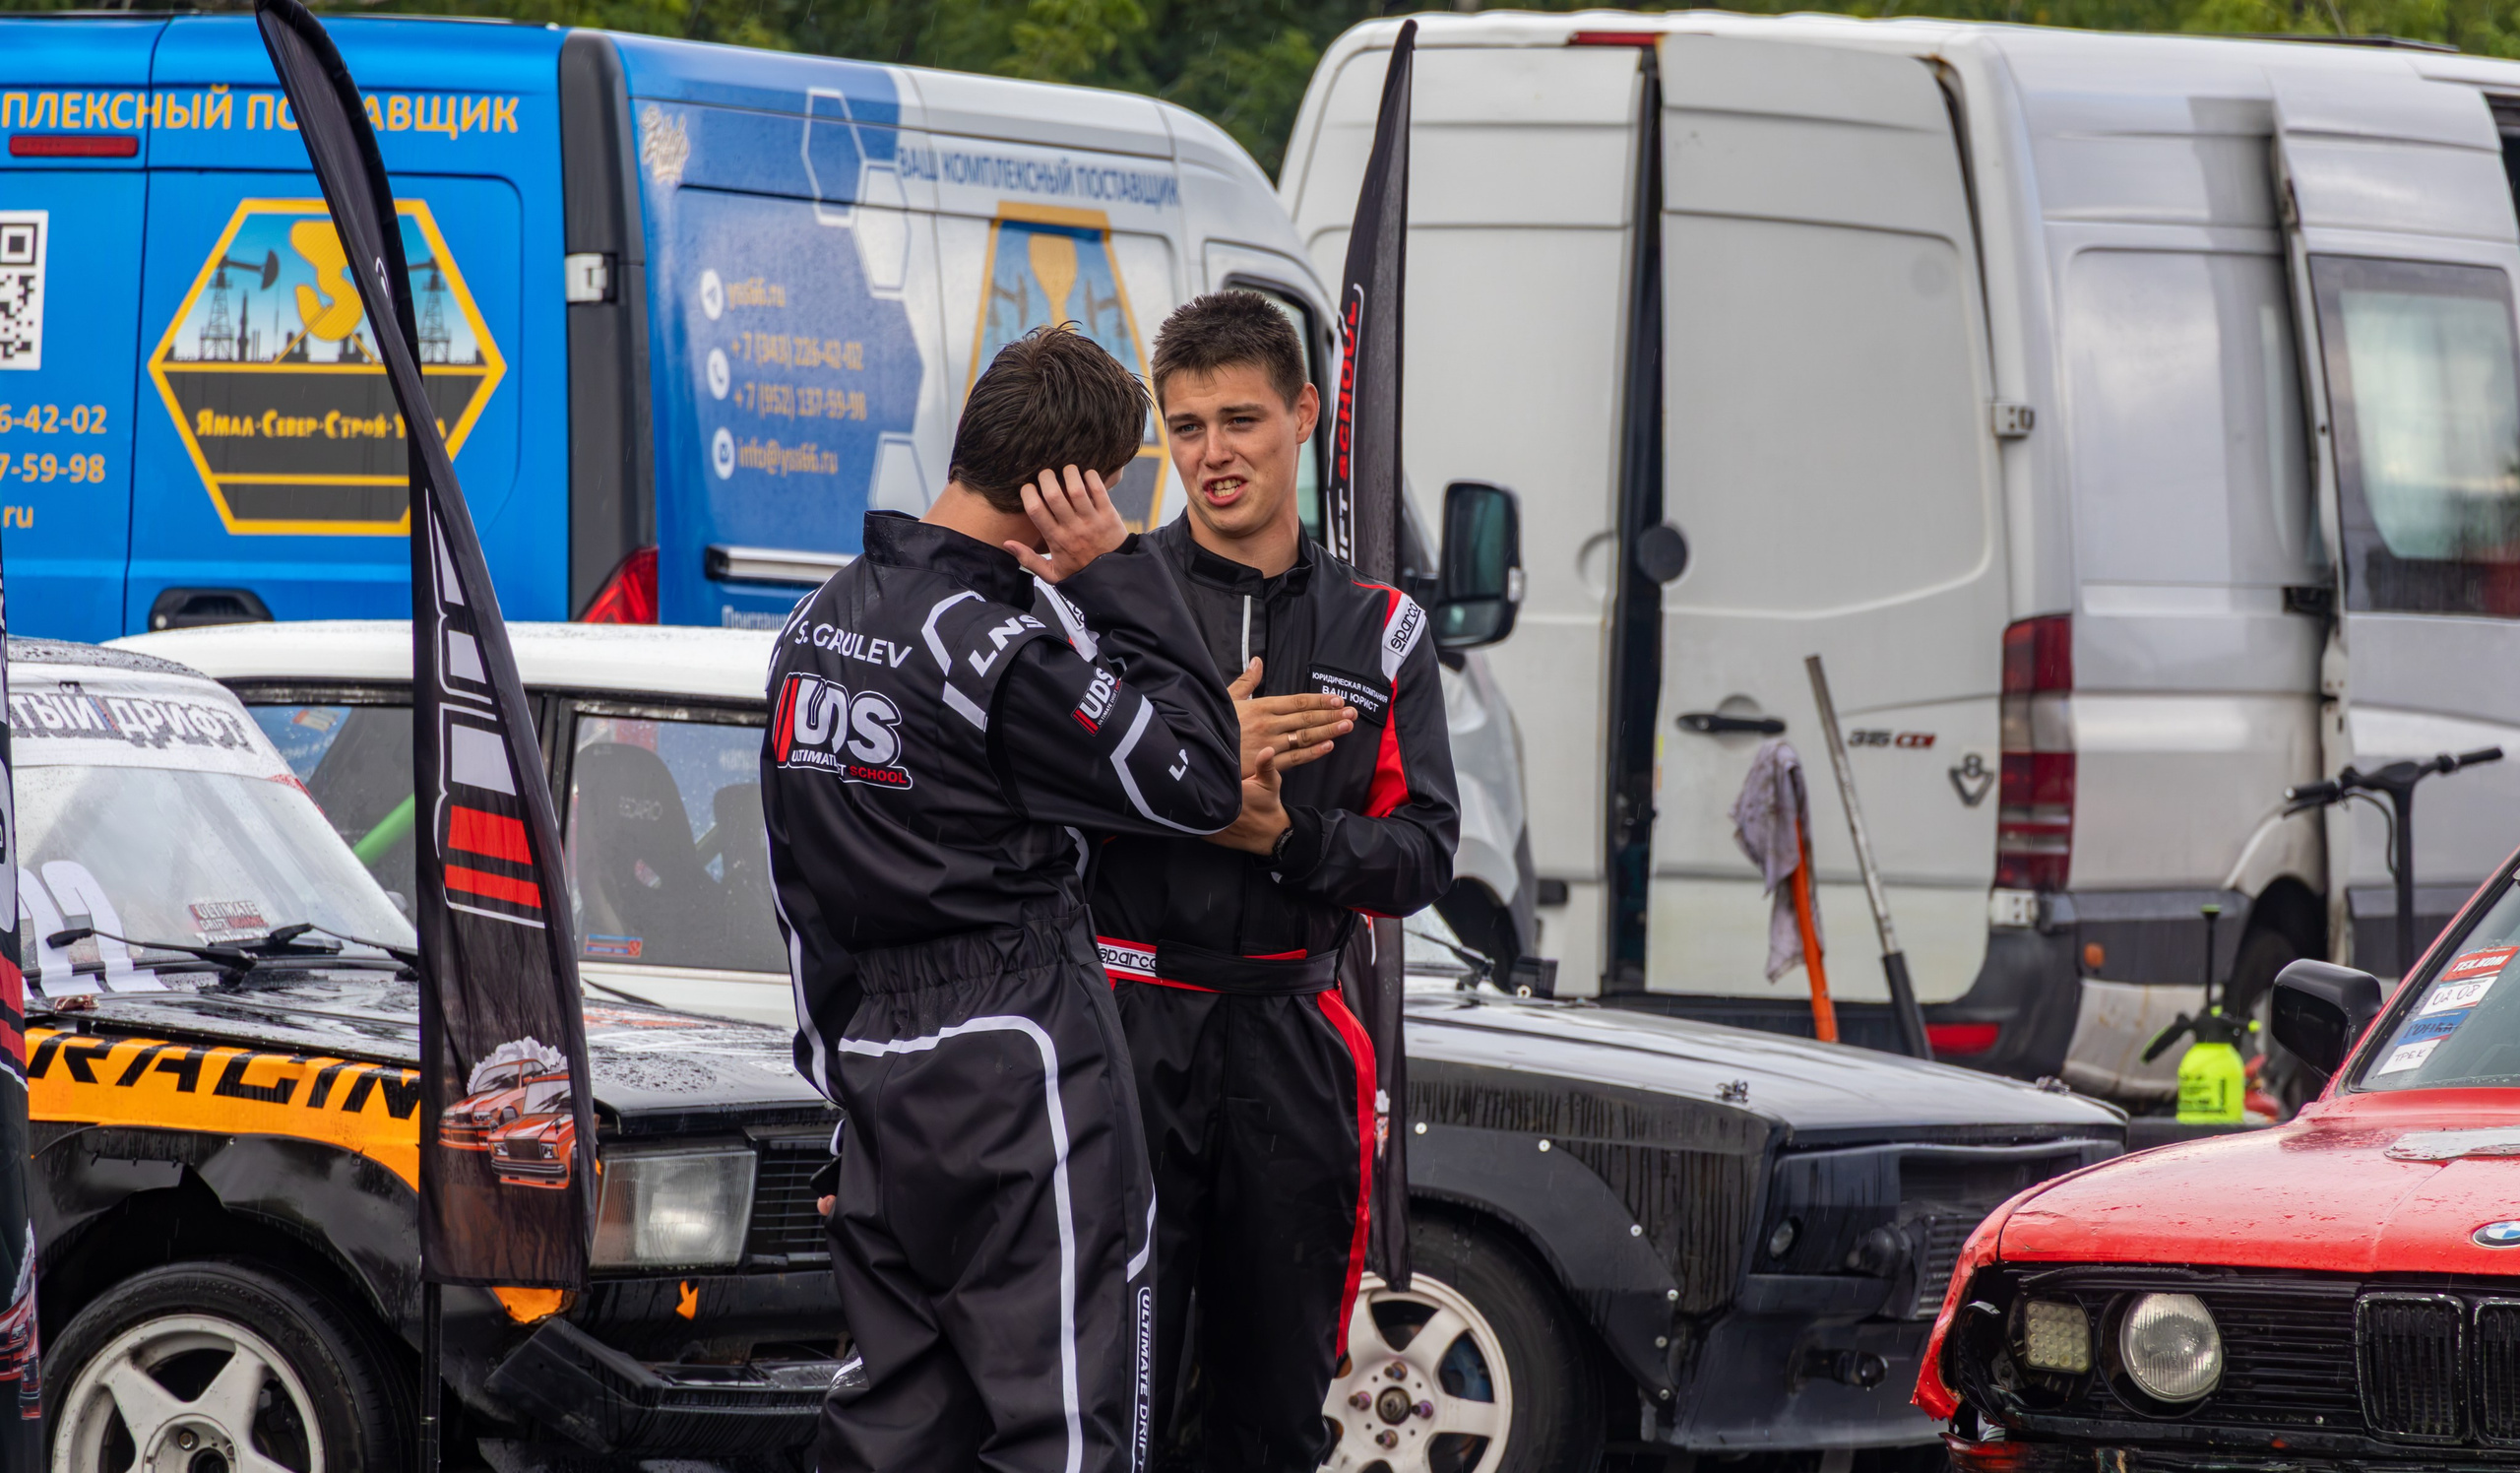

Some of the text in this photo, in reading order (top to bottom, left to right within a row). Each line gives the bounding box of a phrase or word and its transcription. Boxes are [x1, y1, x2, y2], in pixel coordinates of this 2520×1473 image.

[246, 93, 520, 141] ПОАВЩИК
[898, 147, 1180, 213] ВАШ КОМПЛЕКСНЫЙ ПОСТАВЩИК
[0, 404, 107, 434] 6-42-02
[0, 453, 105, 483] 7-59-98
[969, 614, 1046, 677] LNS
[1390, 603, 1418, 652] sparco
[1078, 667, 1116, 720] UDS
[1312, 672, 1389, 703] ЮРИДИЧЕСКАЯ КОМПАНИЯ
[1322, 685, 1379, 712] ВАШ ЮРИСТ
[9, 680, 108, 737] ТЫЙ
[104, 696, 253, 750] ДРИФТ
[850, 765, 908, 784] SCHOOL
[194, 902, 260, 919] ULTIMATE
[27, 1032, 421, 1120] RACIN
[1140, 1294, 1151, 1397] ULTIMATE
